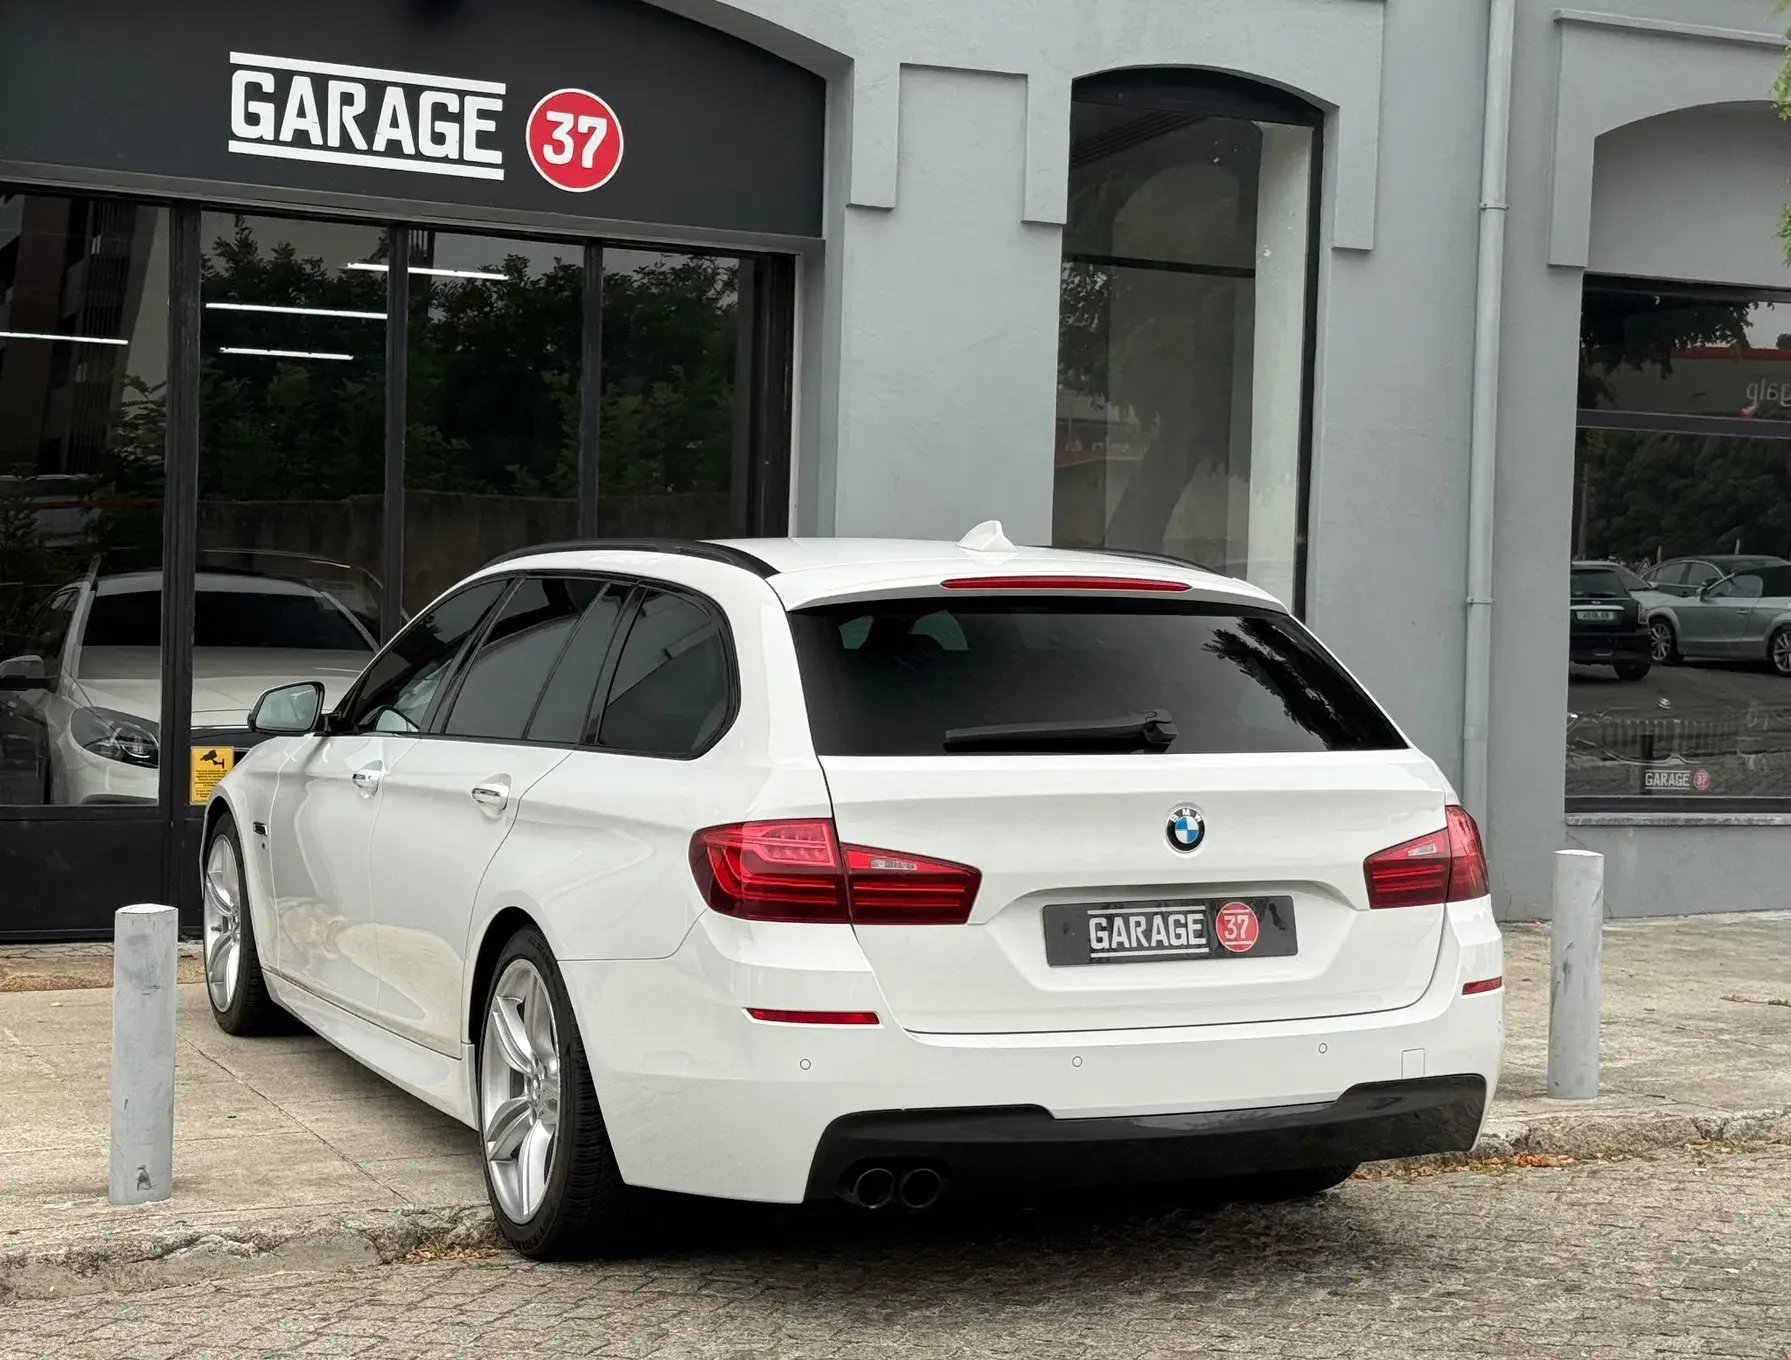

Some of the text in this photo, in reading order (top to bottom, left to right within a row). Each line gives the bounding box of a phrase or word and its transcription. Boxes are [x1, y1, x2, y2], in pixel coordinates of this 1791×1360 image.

[231, 70, 607, 169] GARAGE 37
[1645, 772, 1708, 787] GARAGE 37
[1170, 808, 1202, 823] BMW
[1089, 913, 1250, 950] GARAGE 37
